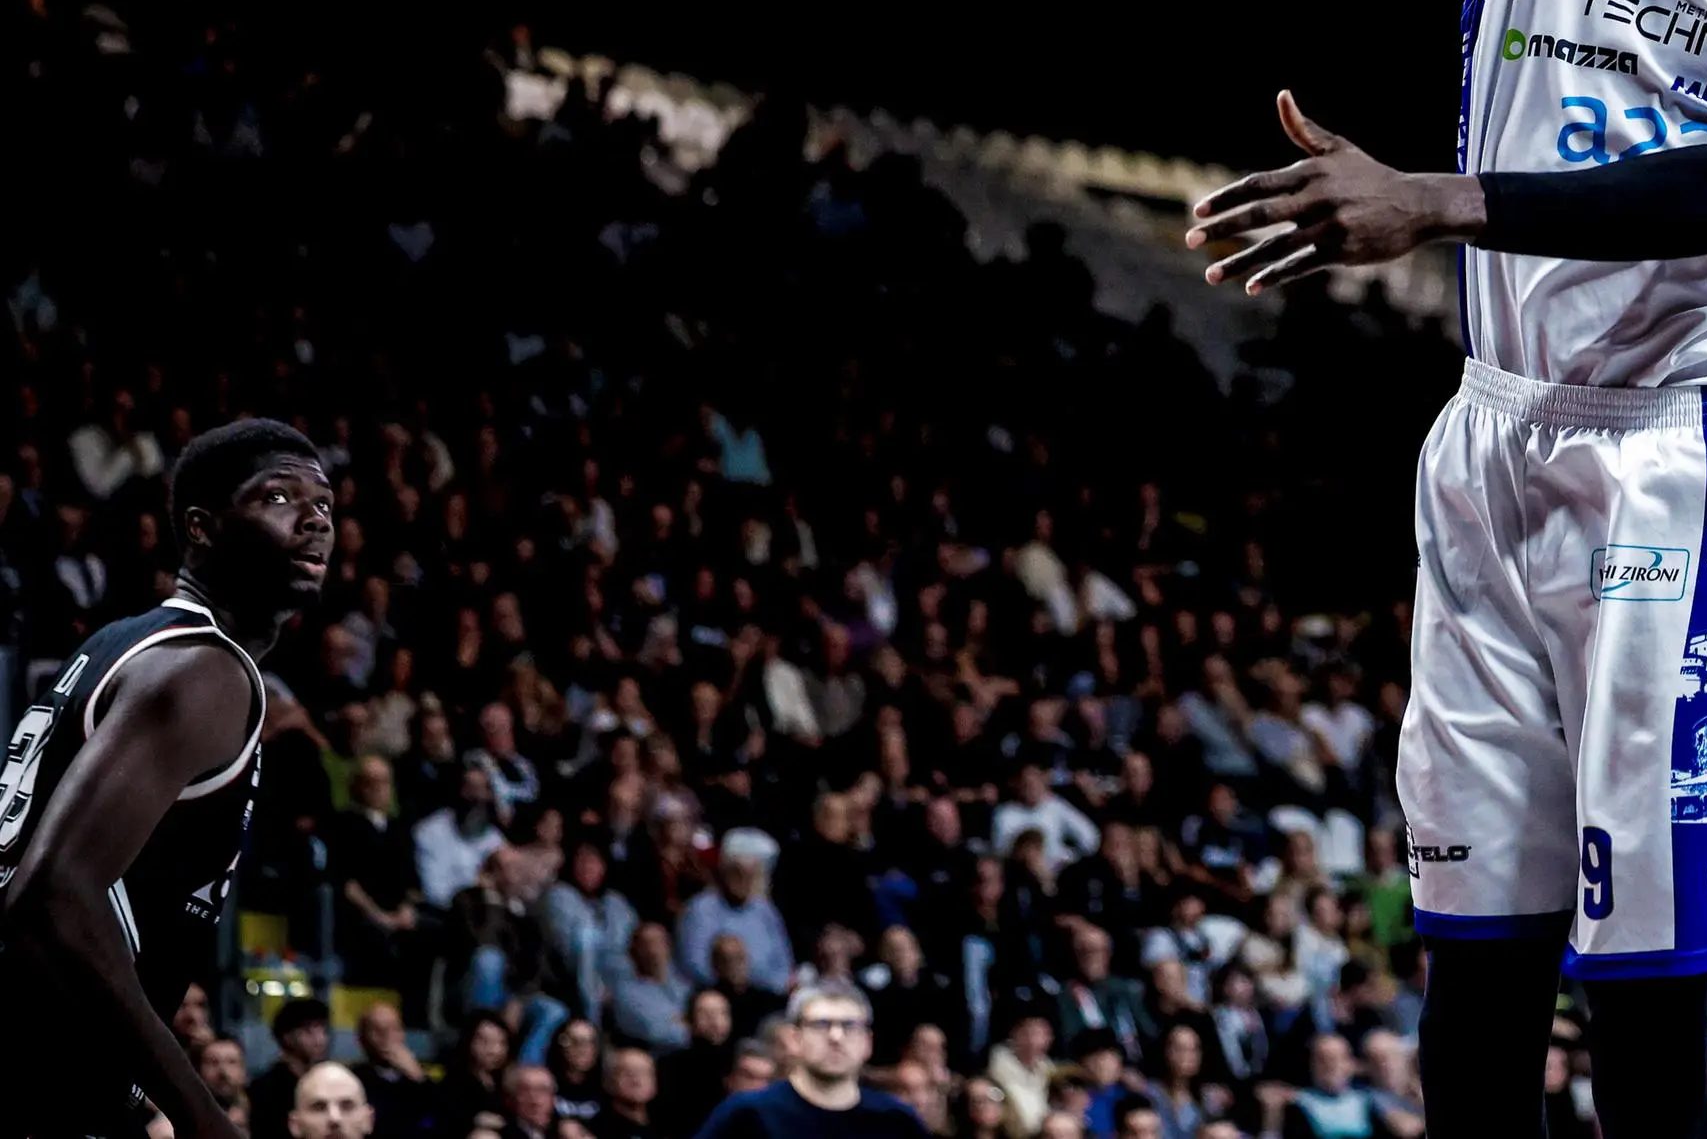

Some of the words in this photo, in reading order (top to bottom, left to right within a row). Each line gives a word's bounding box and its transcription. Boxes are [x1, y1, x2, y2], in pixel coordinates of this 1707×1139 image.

[1619, 565, 1680, 583] ZIRONI
[1582, 825, 1614, 921] 9
[184, 902, 209, 920] THE
